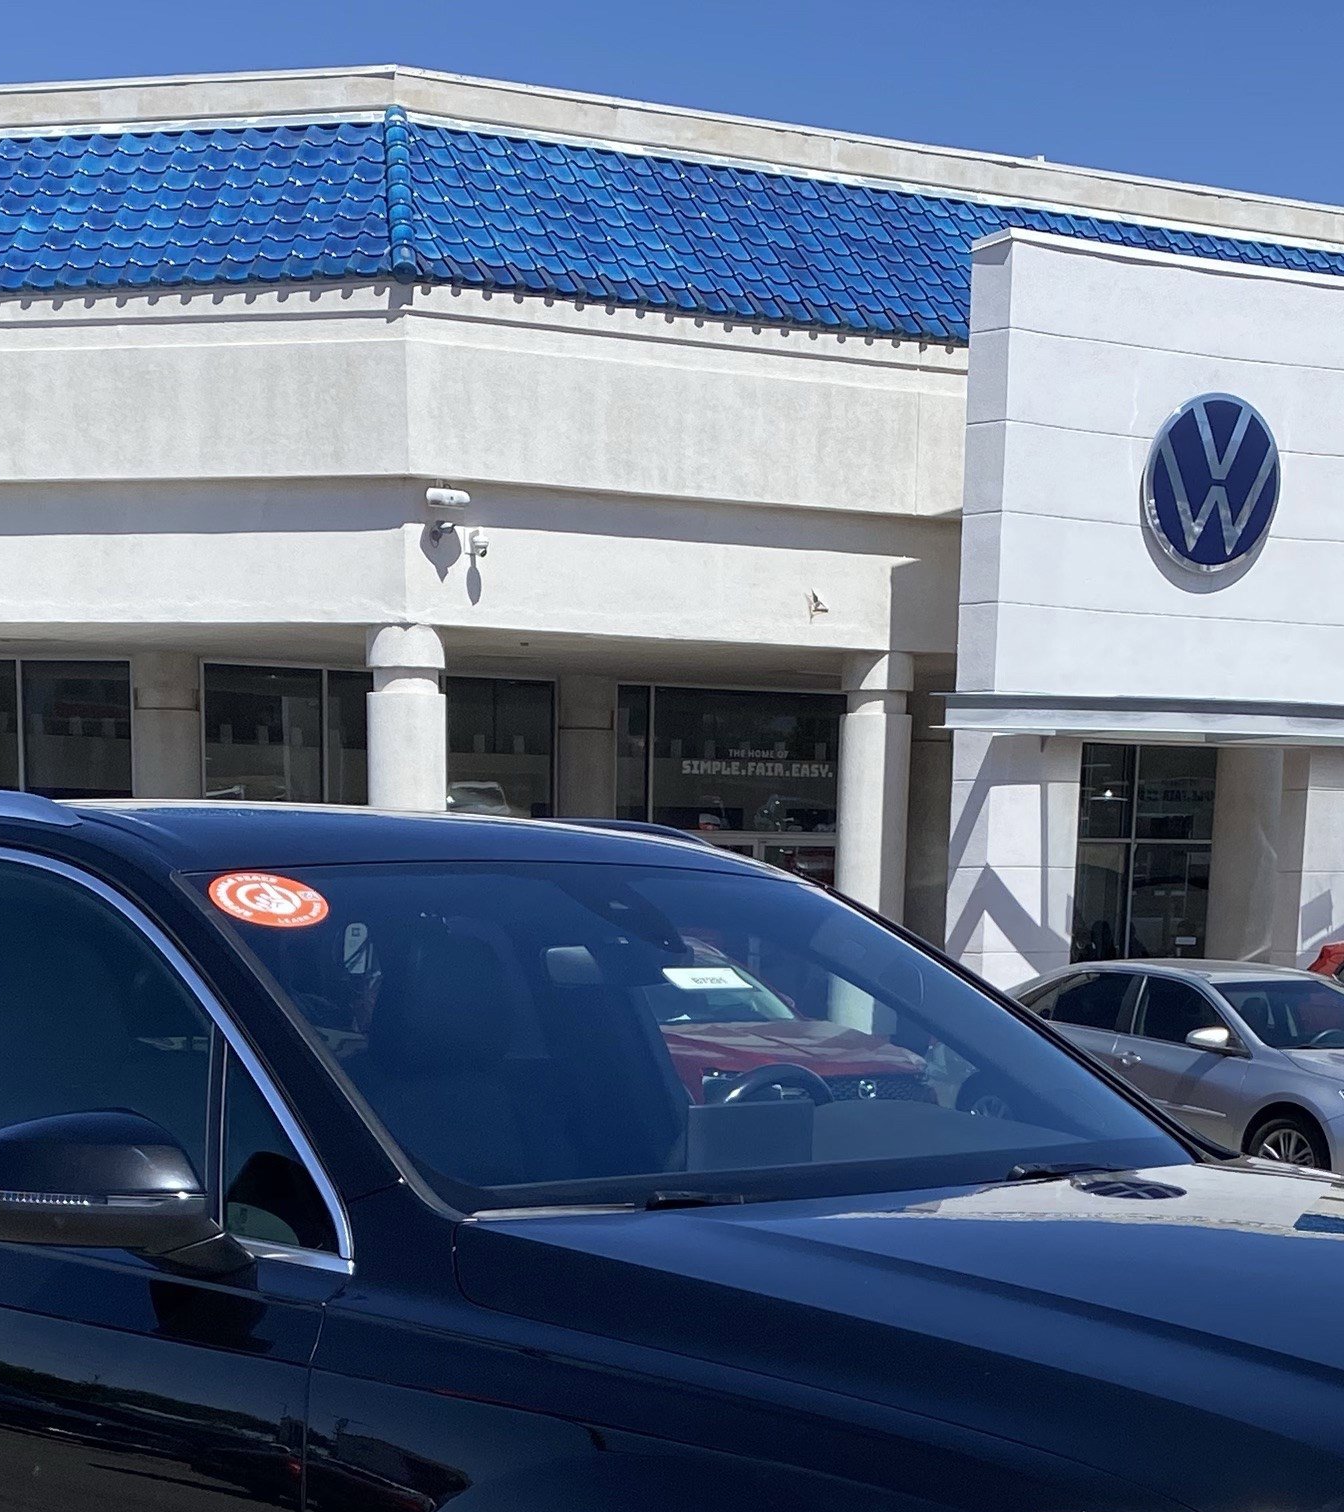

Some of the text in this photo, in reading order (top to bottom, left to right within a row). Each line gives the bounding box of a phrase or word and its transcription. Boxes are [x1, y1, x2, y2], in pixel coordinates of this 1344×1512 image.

[1149, 395, 1279, 566] VW
[728, 748, 745, 758] THE
[748, 748, 774, 759] HOME
